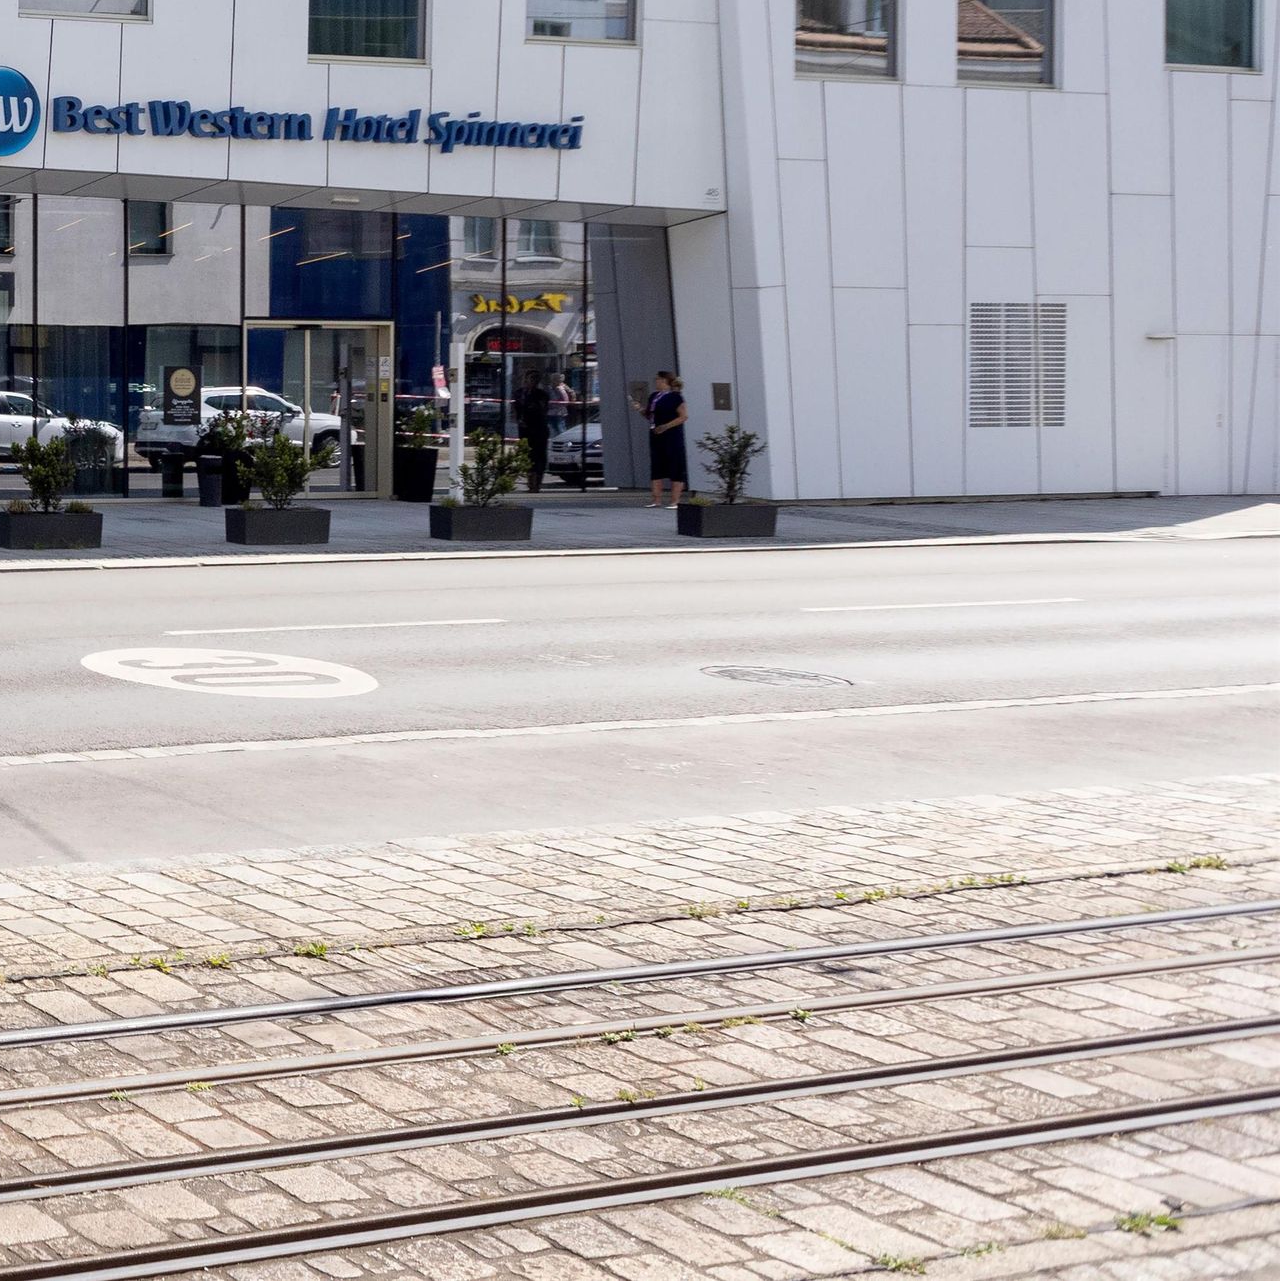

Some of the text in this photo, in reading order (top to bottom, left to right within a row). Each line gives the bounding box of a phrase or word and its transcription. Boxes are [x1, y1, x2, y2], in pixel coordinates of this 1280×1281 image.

[53, 96, 585, 153] Best Western Hotel Spinnerei
